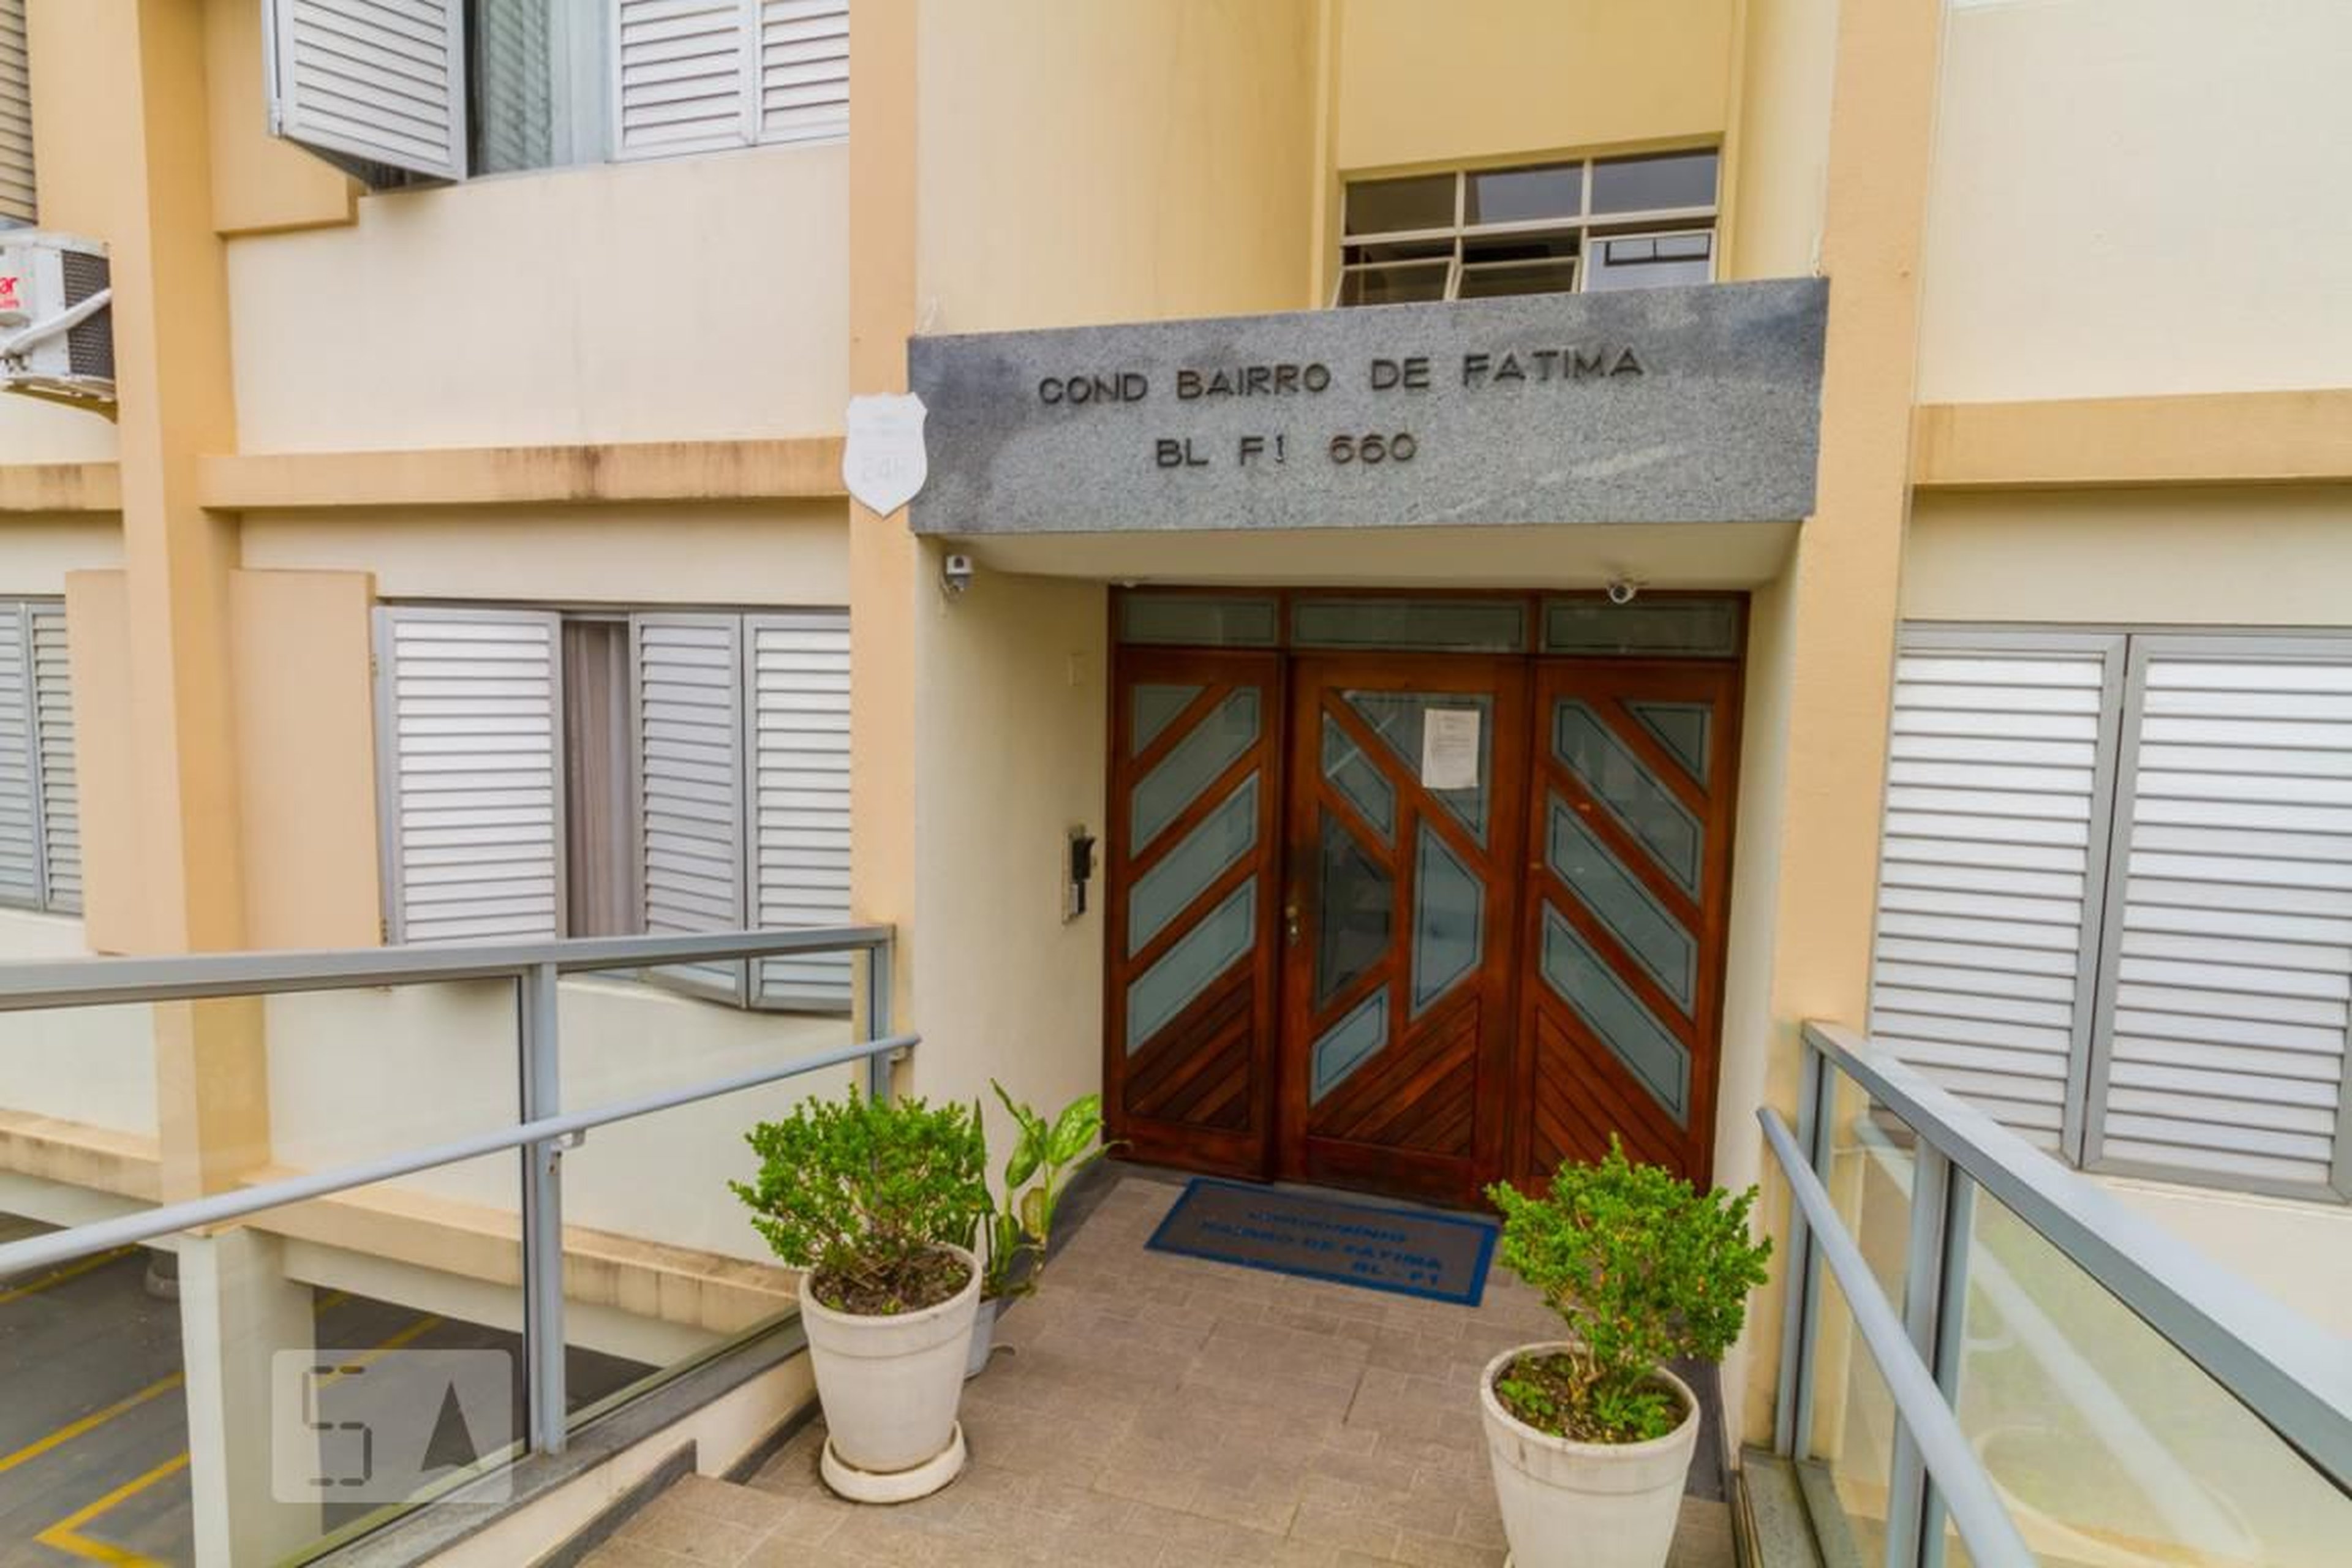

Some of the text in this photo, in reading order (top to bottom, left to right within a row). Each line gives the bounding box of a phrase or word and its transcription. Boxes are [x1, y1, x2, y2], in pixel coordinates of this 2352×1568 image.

[1039, 347, 1644, 404] COND BAIRRO DE FATIMA
[1156, 438, 1208, 467] BL
[1330, 432, 1417, 464] 660
